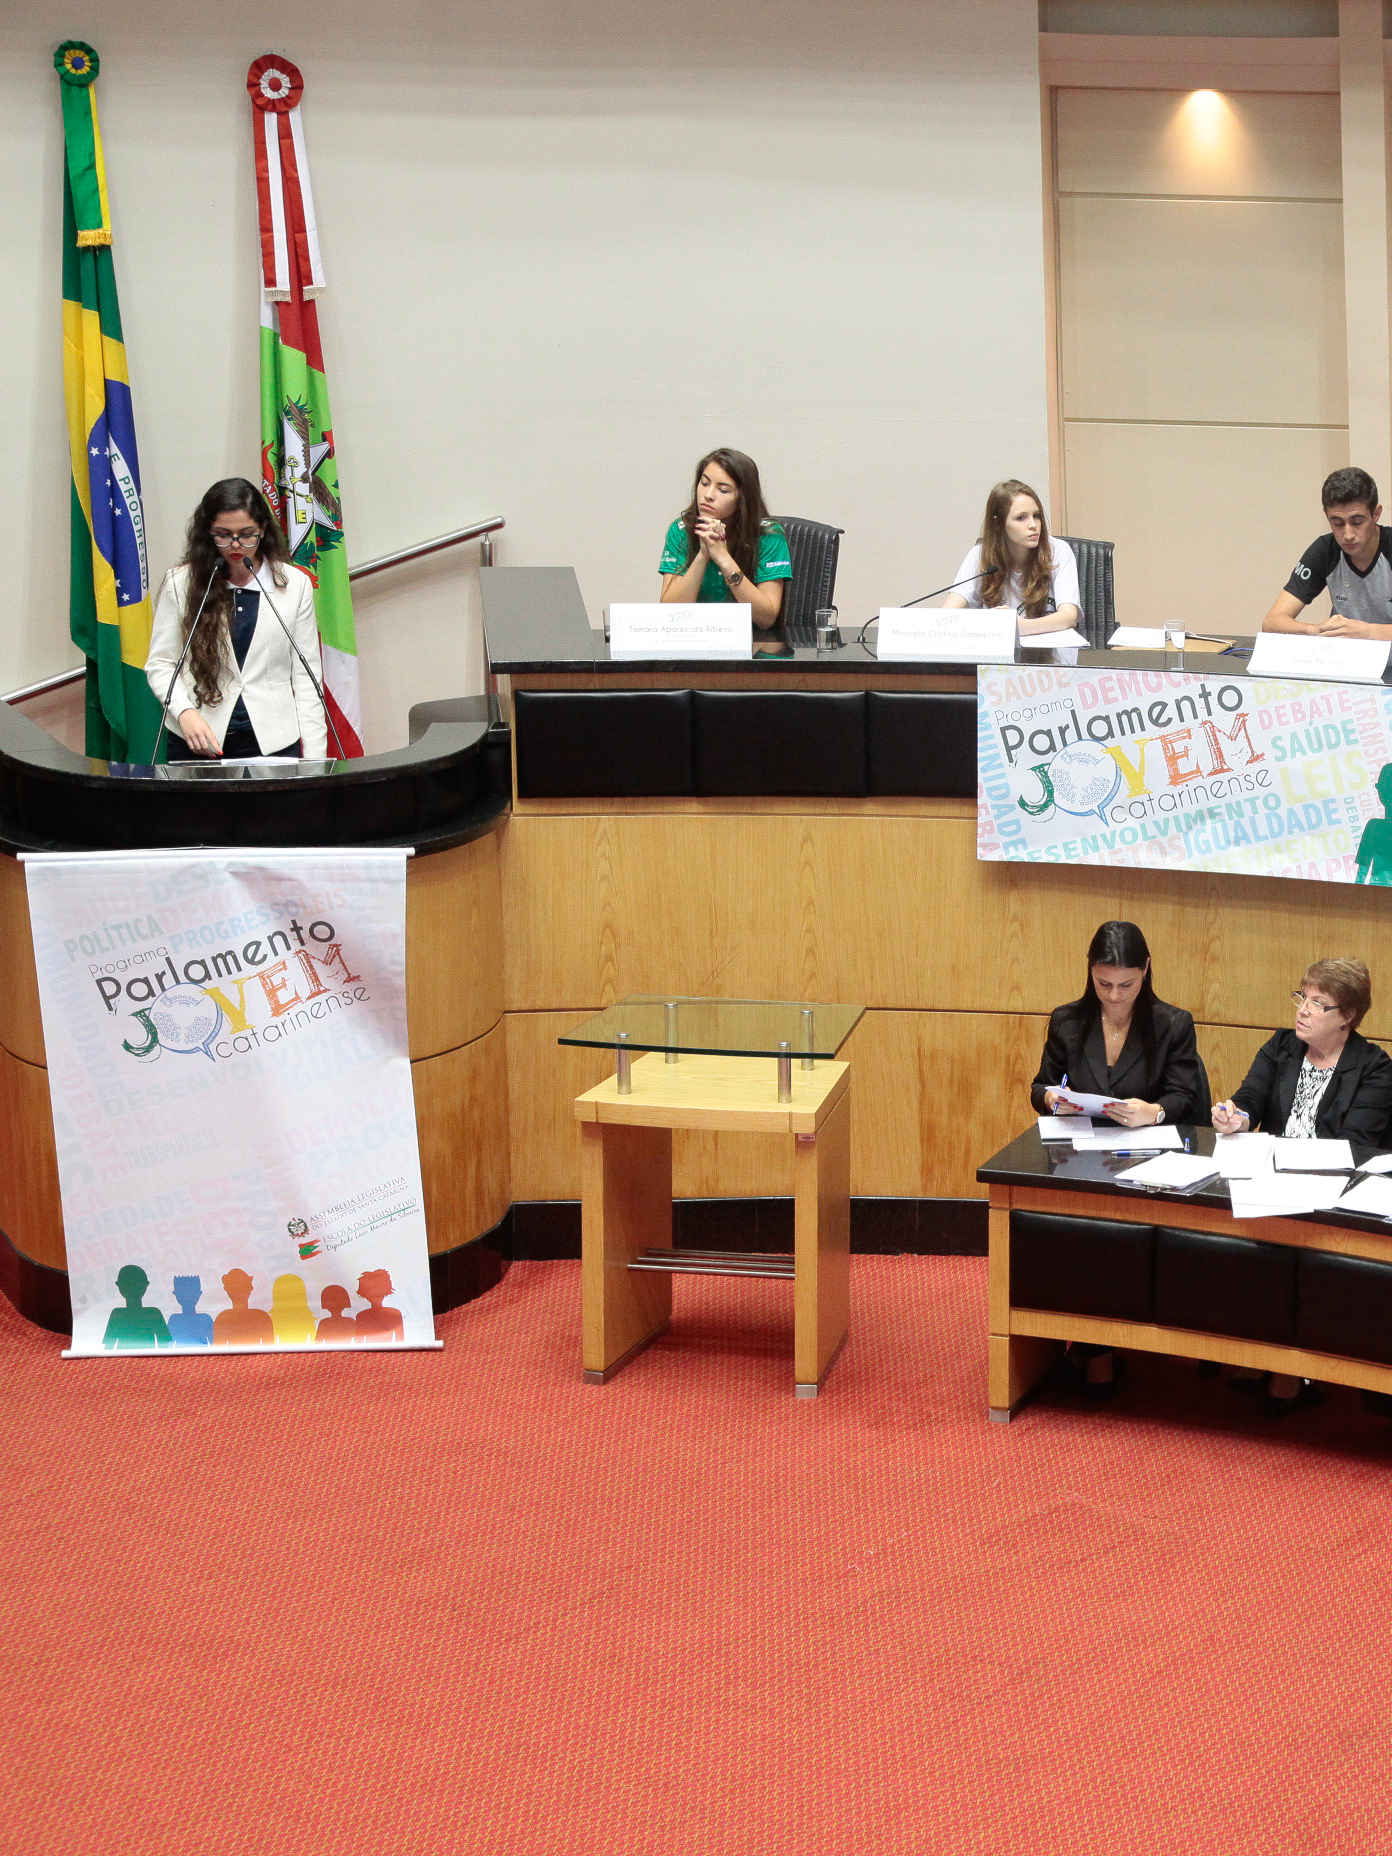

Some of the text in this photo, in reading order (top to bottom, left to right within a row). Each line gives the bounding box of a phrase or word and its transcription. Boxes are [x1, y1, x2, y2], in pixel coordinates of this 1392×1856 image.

[629, 625, 734, 634] Tamara Aparecida Ribeiro
[995, 697, 1075, 725] Programa
[1000, 683, 1243, 765] Parlamento
[1257, 690, 1354, 731] DEBATE
[1271, 719, 1360, 763] SAÚDE
[1110, 769, 1273, 824] catarinense
[1279, 749, 1370, 806] LEIS
[1182, 797, 1343, 858] IGUALDADE
[62, 913, 166, 963] POLÍTICA
[168, 898, 300, 955] PROGRESSO
[88, 946, 169, 979] Programa
[95, 918, 336, 1013] Parlamento
[215, 986, 371, 1059] catarinense
[311, 1184, 410, 1231] DO ESTADO DE SANTA CATARINA
[356, 1176, 406, 1202] LEGISLATIVA
[322, 1197, 418, 1243] ESCOLA DO LEGISLATIVO
